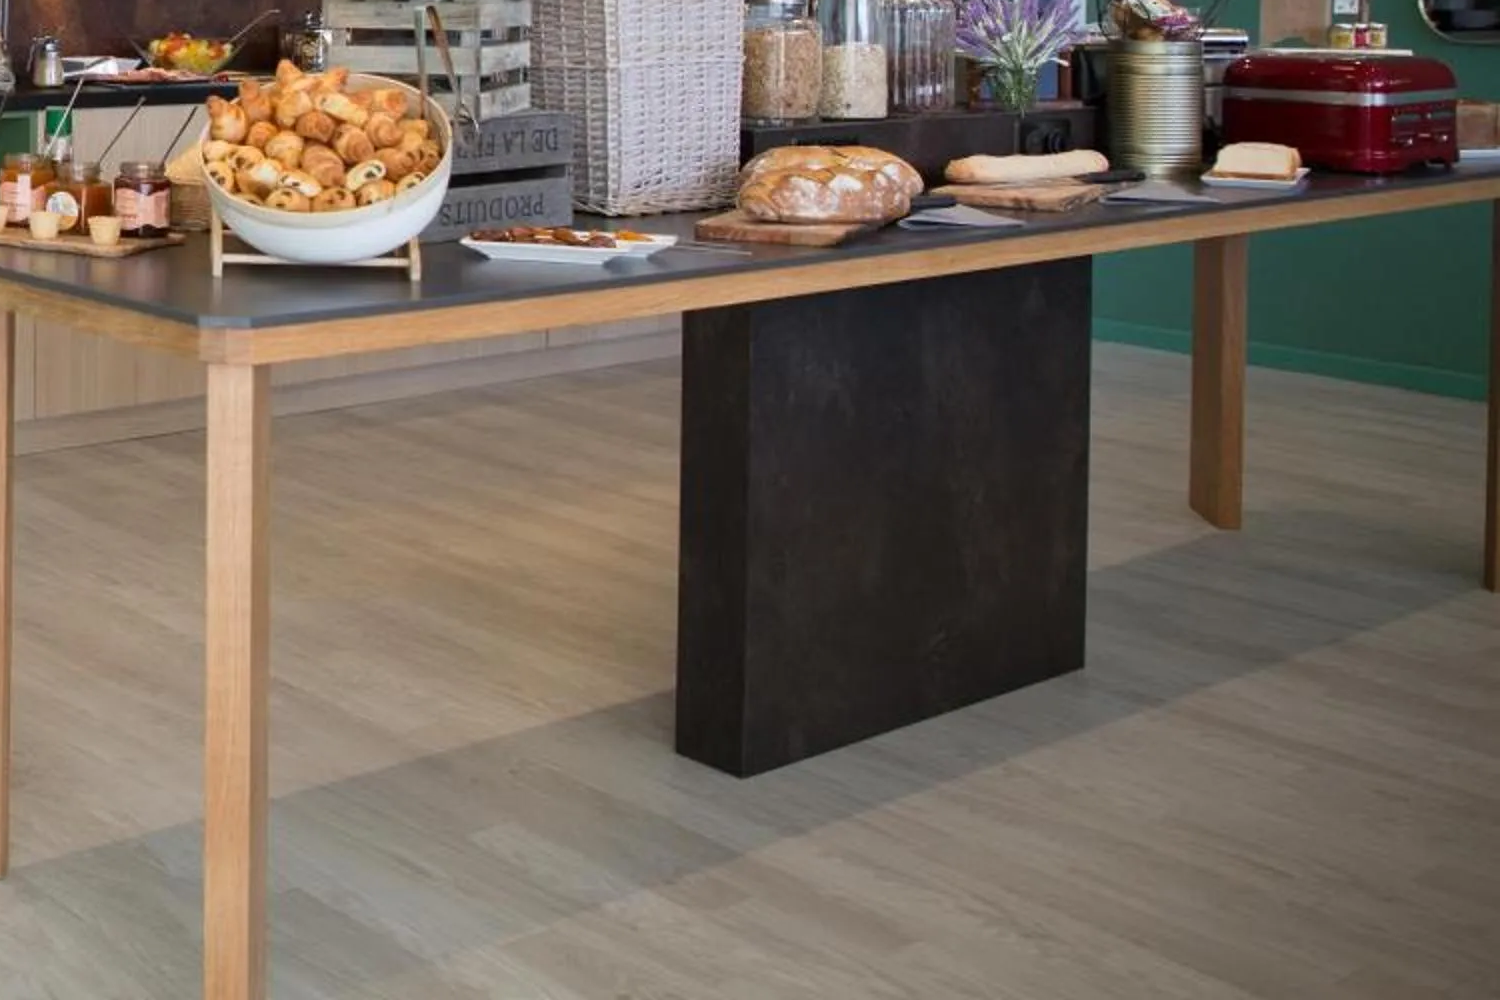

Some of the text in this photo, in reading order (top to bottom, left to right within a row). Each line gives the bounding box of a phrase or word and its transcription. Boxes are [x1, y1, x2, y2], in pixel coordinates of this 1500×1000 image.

[503, 130, 526, 155] LA
[531, 128, 559, 154] DE
[439, 194, 545, 225] PRODUITS
